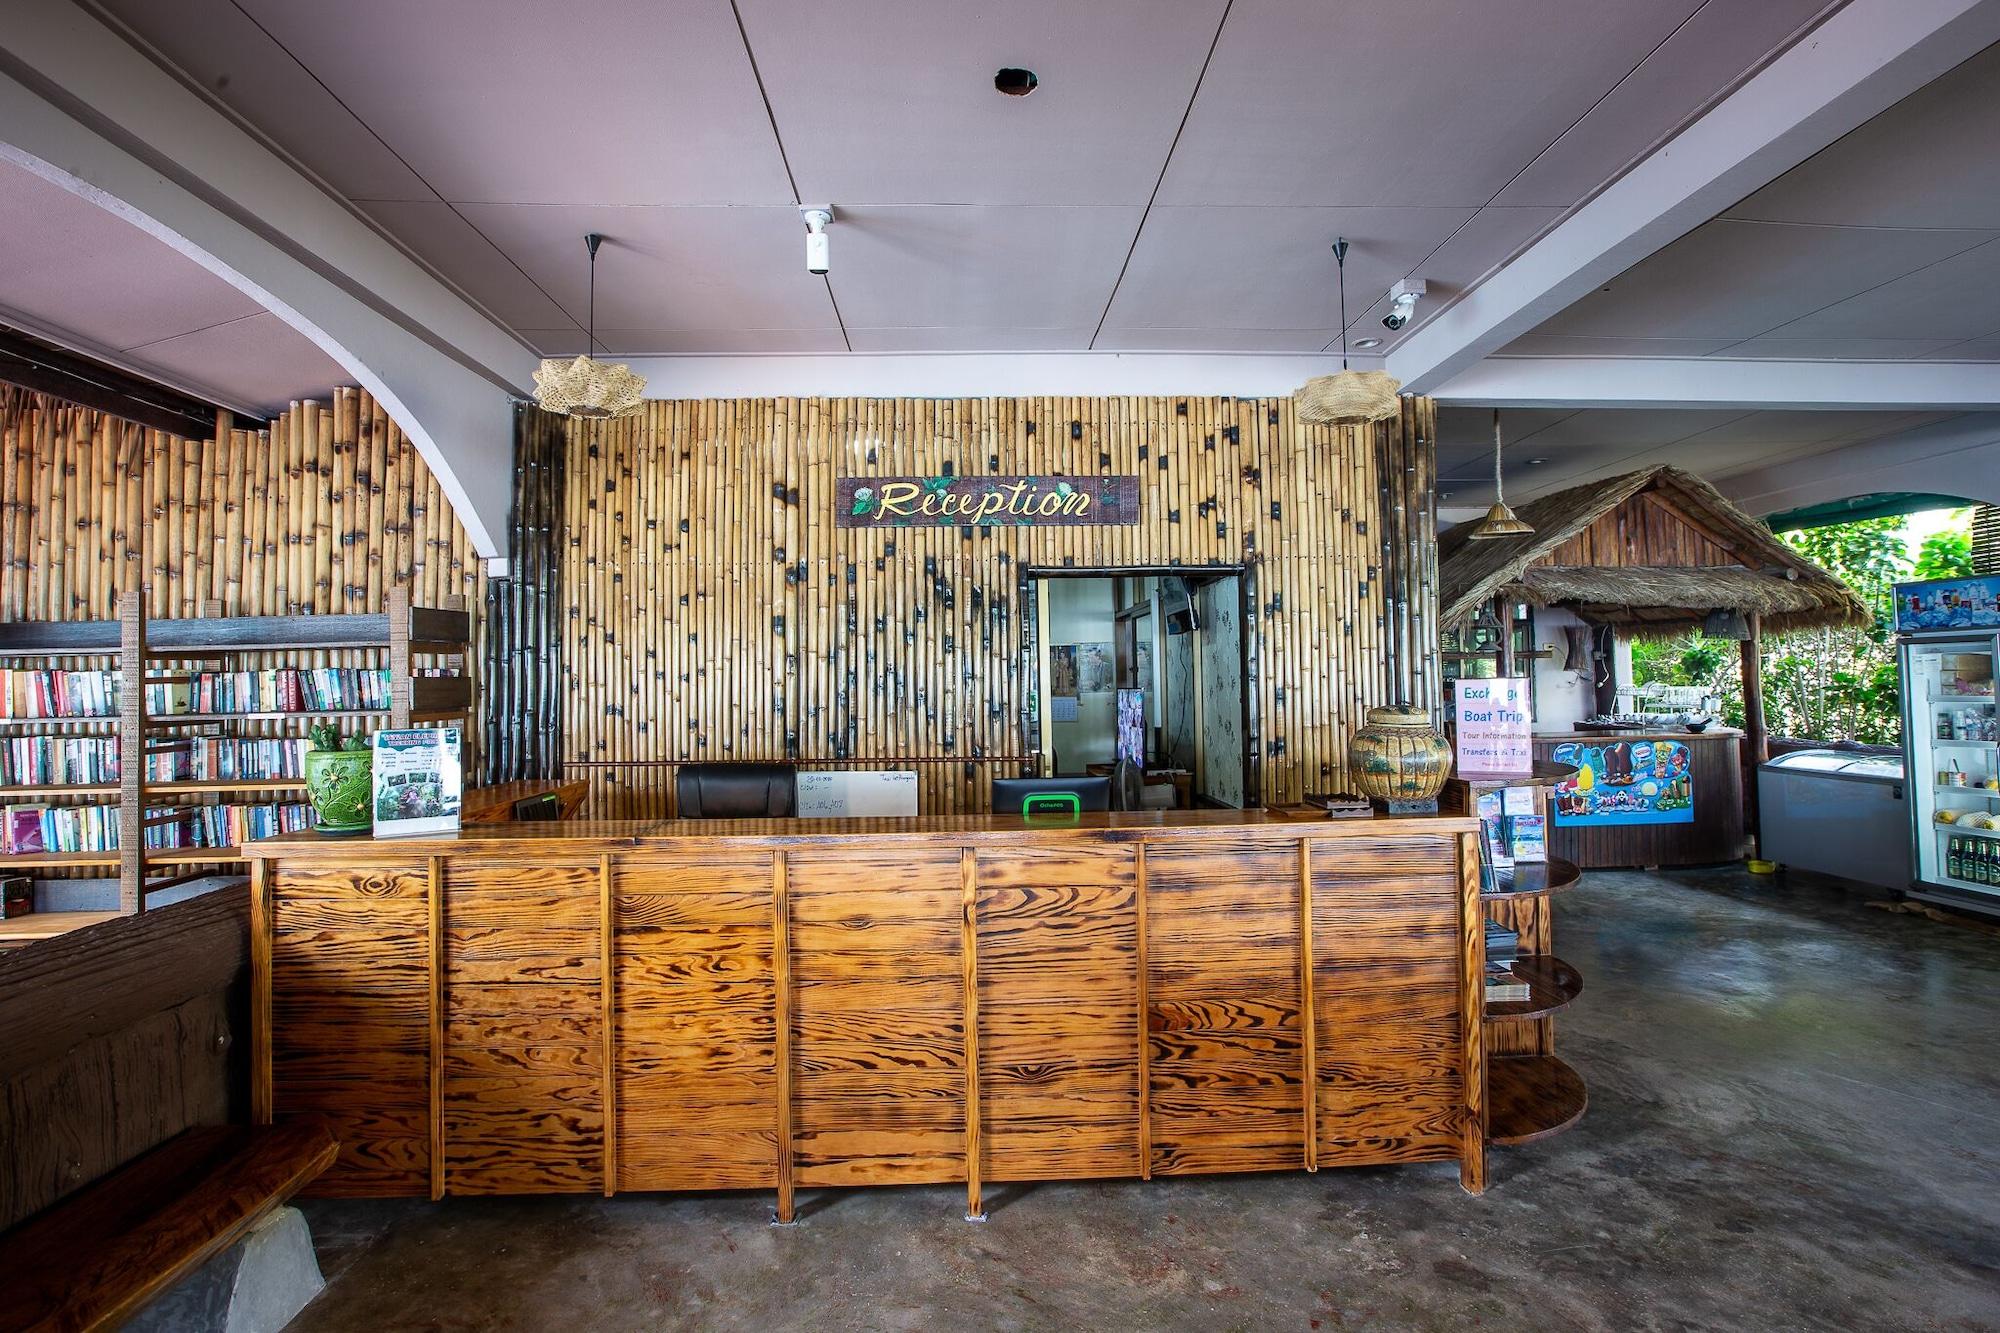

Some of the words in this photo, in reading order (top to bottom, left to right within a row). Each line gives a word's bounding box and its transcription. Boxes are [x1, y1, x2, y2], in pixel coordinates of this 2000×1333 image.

[873, 480, 1091, 523] Reception
[1464, 687, 1518, 700] Exchg
[1464, 710, 1493, 722] Boat
[1497, 709, 1523, 724] Trip
[1482, 732, 1527, 740] Information
